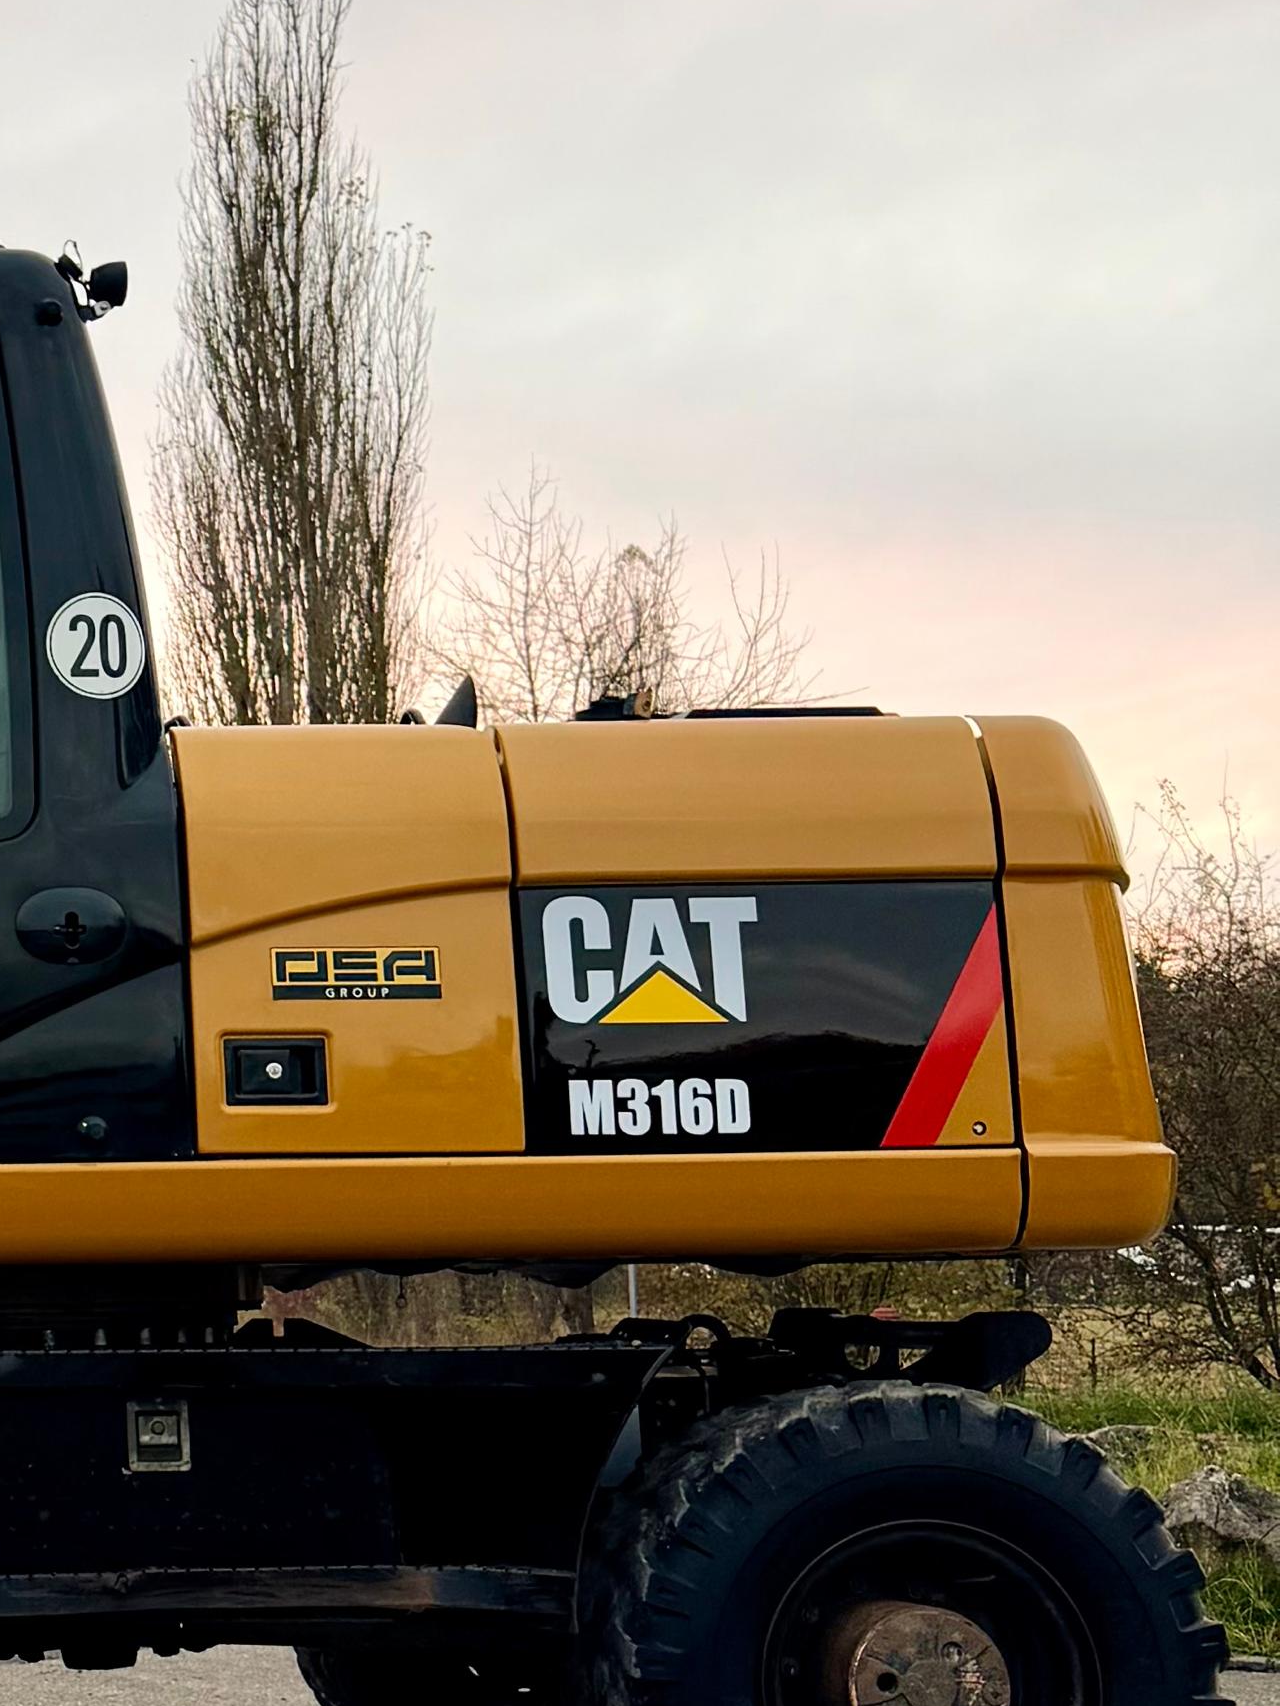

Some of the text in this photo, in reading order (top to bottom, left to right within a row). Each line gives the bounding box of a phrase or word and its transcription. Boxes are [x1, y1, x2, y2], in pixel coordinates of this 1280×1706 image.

[69, 614, 128, 678] 20
[542, 896, 759, 1024] CAT
[325, 987, 390, 998] GROUP
[568, 1078, 751, 1136] M316D
